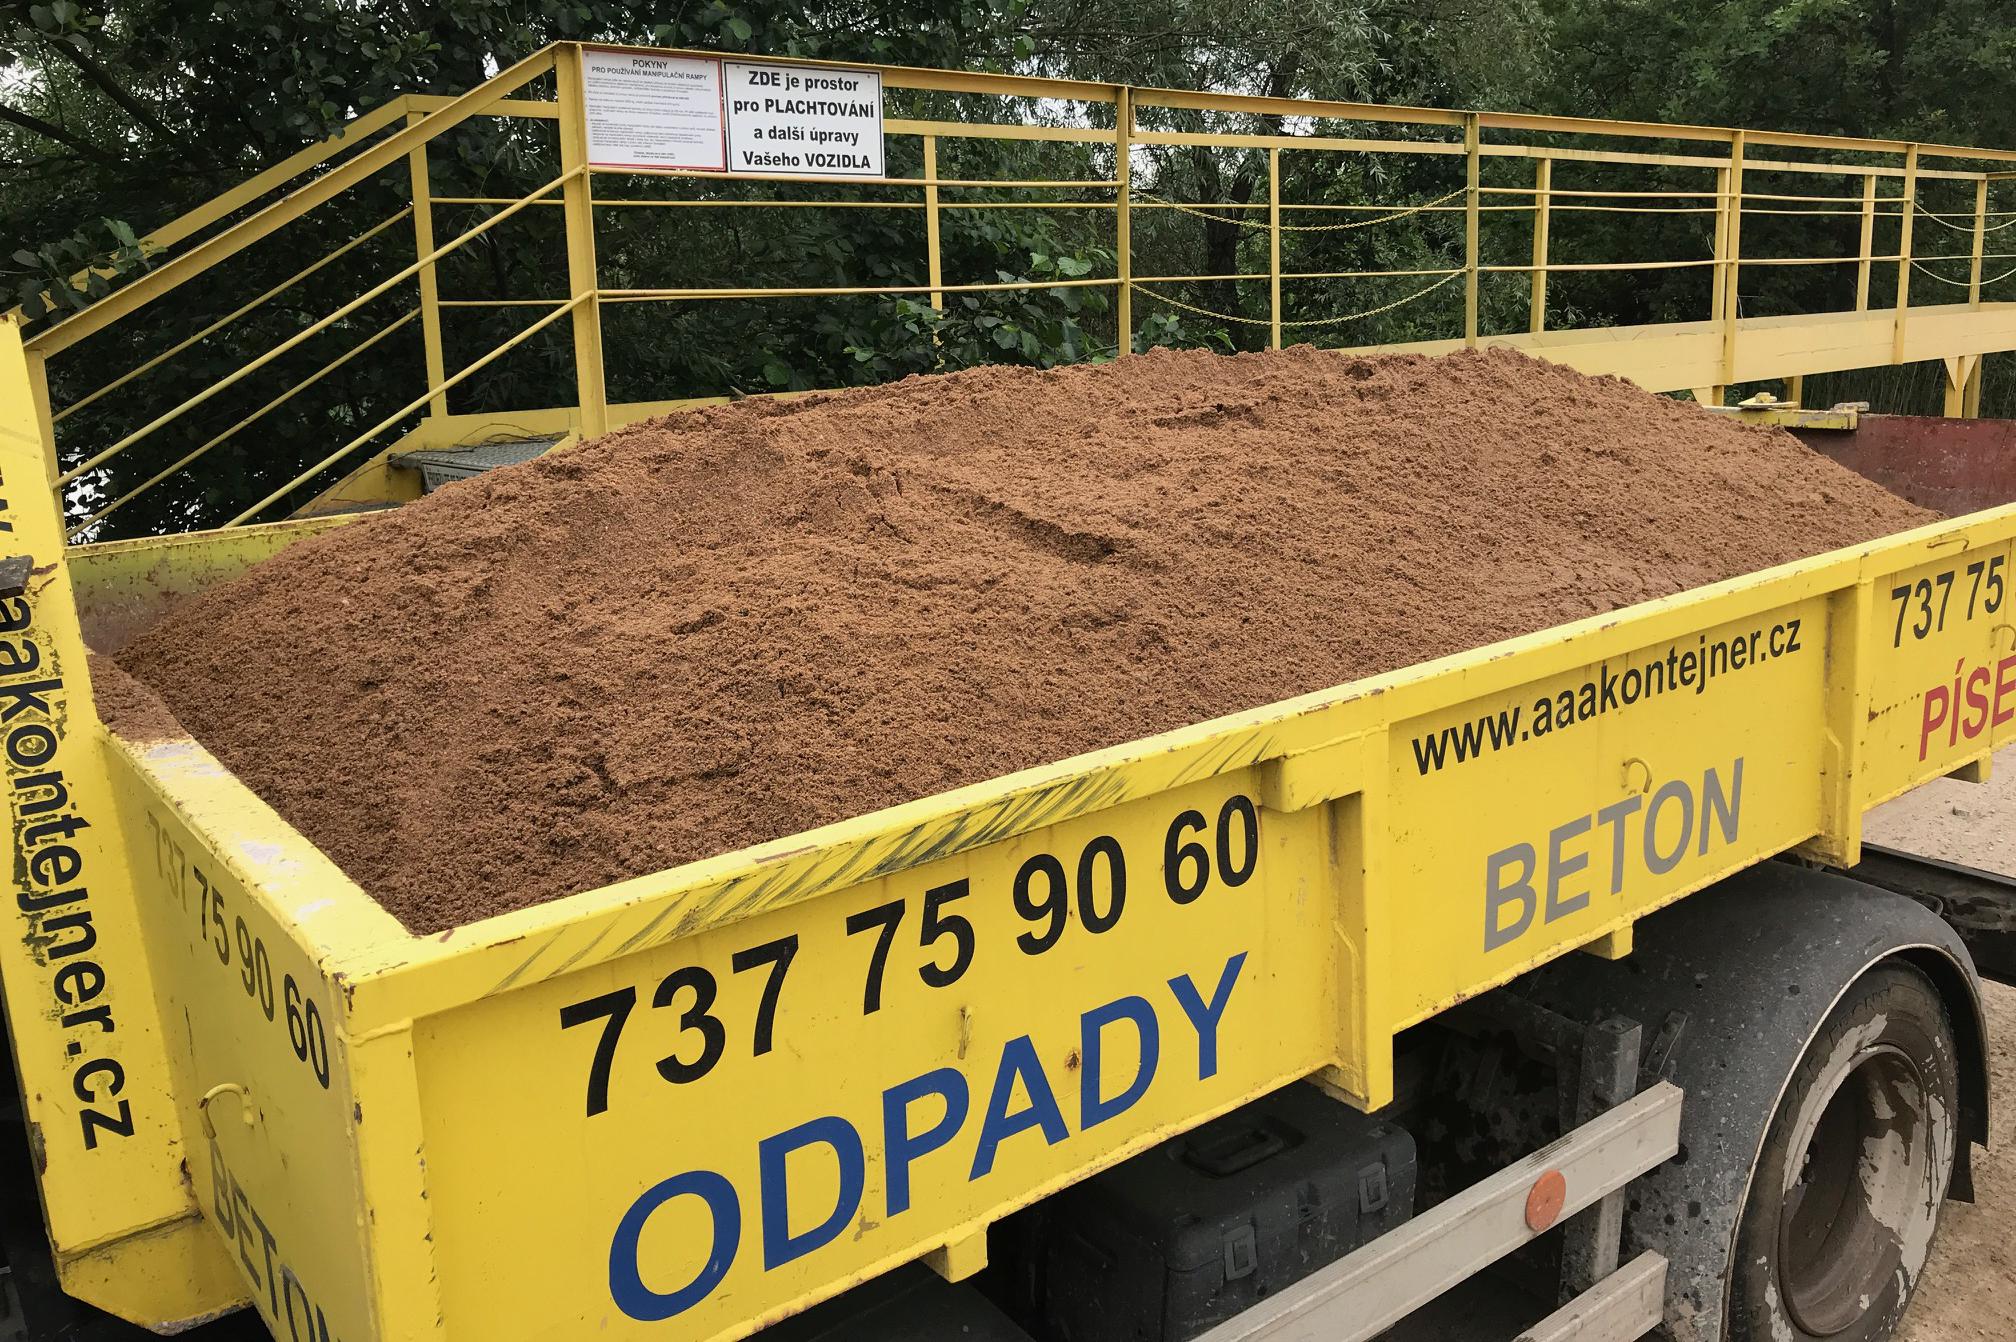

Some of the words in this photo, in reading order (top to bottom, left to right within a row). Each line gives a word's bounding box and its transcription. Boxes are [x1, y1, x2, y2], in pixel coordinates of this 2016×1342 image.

[591, 66, 606, 74] PRO
[607, 67, 641, 77] POUŽÍVÁNÍ
[642, 70, 685, 80] MANIPULAČNÍ
[686, 73, 707, 81] RAMPY
[632, 59, 668, 70] POKYNY
[748, 70, 781, 87] ZDE
[785, 73, 800, 91] je
[805, 77, 859, 92] prostor
[733, 99, 760, 115] pro
[765, 98, 875, 118] PLACHTOVÁNÍ
[753, 128, 763, 139] a
[768, 125, 805, 141] další
[809, 127, 859, 147] úpravy
[742, 150, 800, 167] Vašeho
[804, 152, 871, 169] VOZIDLA
[1891, 570, 1956, 649] 737
[1967, 554, 2005, 621] 75
[1411, 619, 1801, 776] www.aaakontejner.cz
[1484, 756, 1744, 953] BETON
[147, 809, 187, 914] 737
[193, 864, 230, 966] 75
[235, 915, 275, 1023] 90
[284, 973, 330, 1090] 60
[560, 933, 799, 1118] 737
[846, 877, 975, 1015] 75
[1012, 834, 1127, 955] 90
[1163, 794, 1258, 905] 60
[609, 950, 1248, 1322] ODPADY
